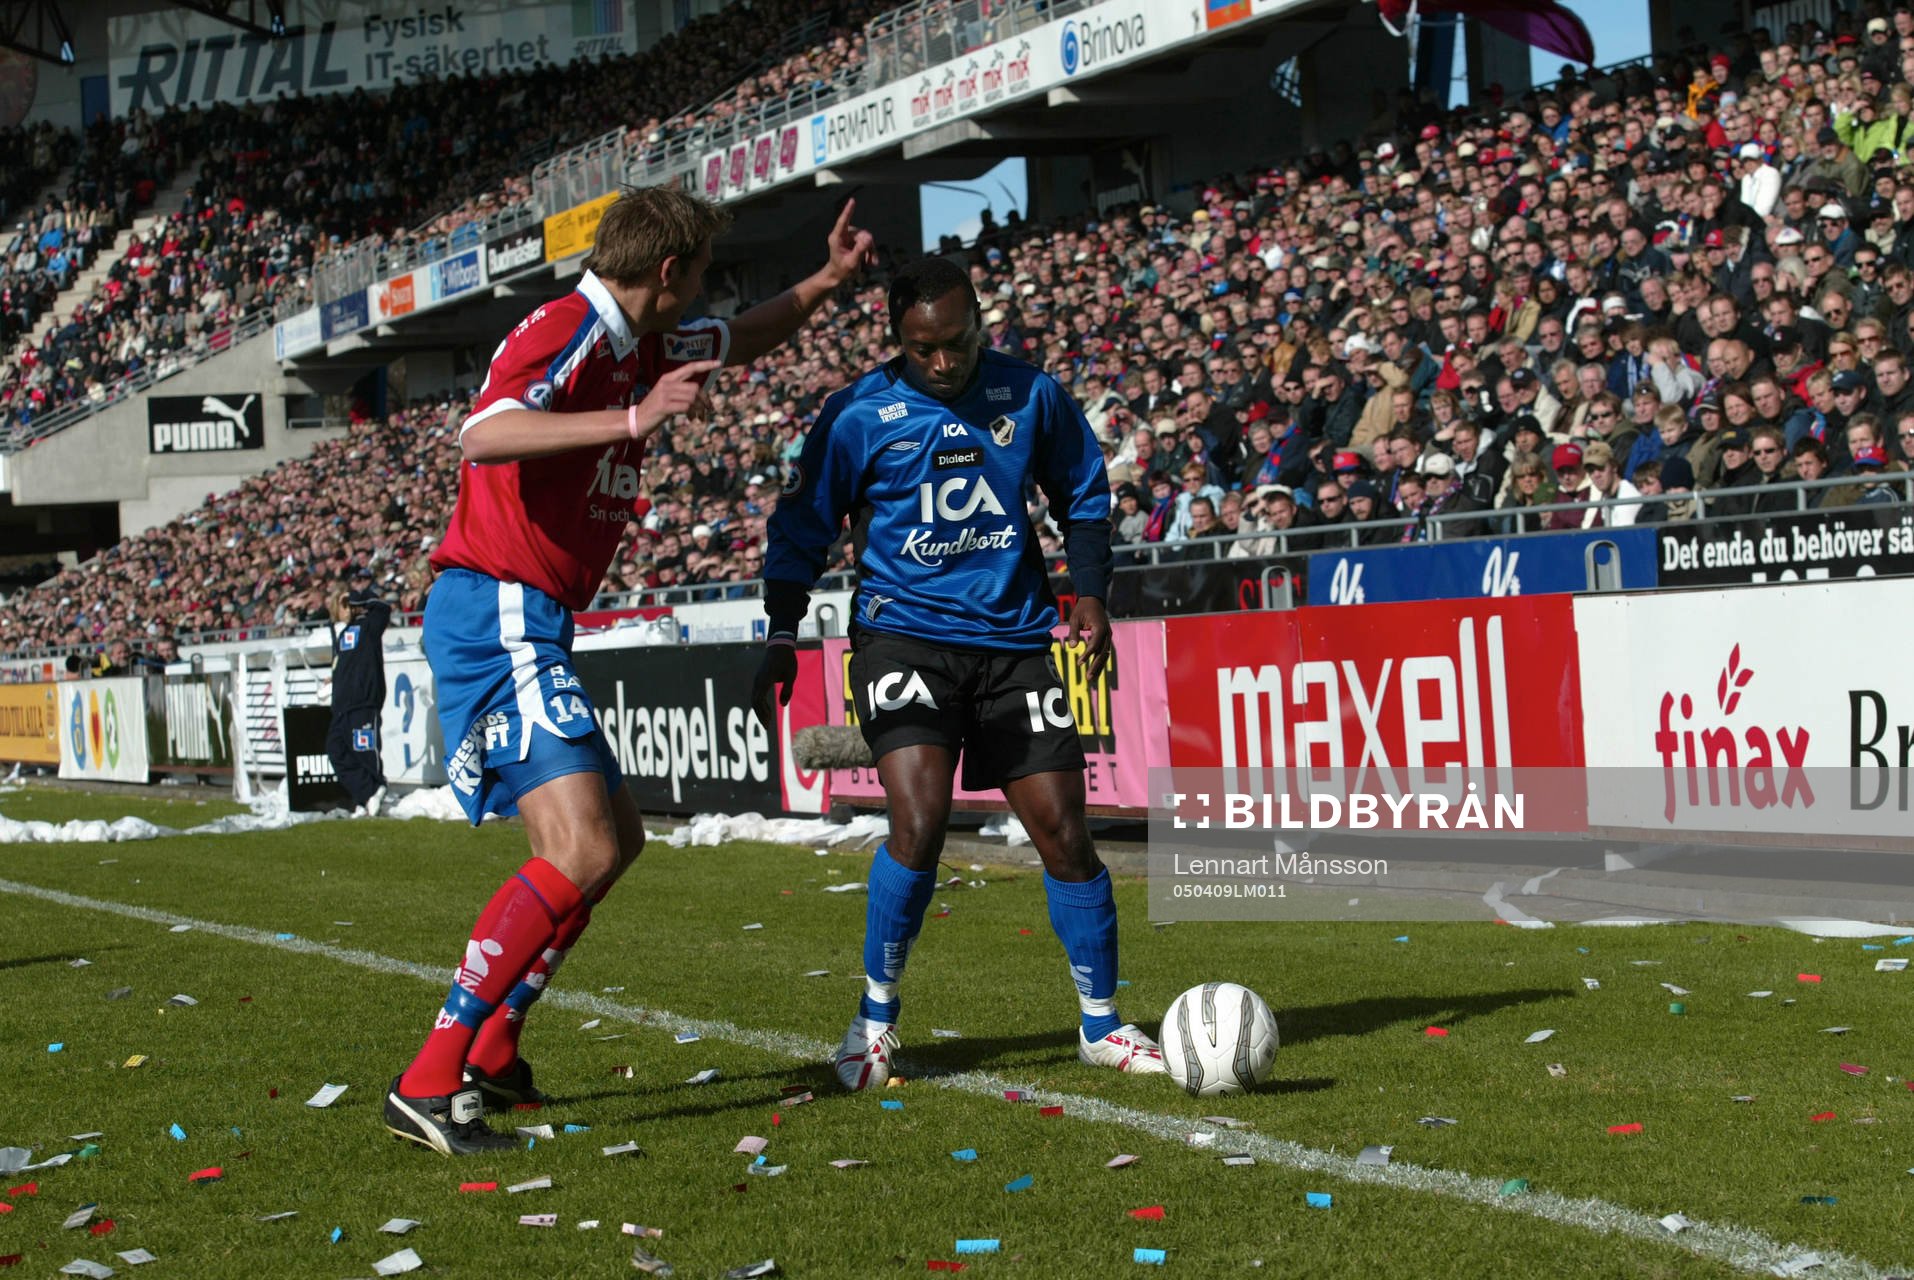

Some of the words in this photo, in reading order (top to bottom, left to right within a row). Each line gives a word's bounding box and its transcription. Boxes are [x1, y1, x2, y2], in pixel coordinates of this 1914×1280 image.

[364, 6, 465, 47] Fysisk
[573, 37, 625, 56] RITTAL
[1080, 13, 1145, 66] Brinova
[118, 21, 347, 111] RITTAL
[366, 34, 549, 80] IT-säkerhet
[829, 96, 896, 154] ARMATUR
[153, 420, 235, 452] PUMA
[943, 424, 969, 437] ICA
[938, 453, 975, 465] Dialect
[920, 474, 1007, 523] ICA
[900, 525, 1017, 567] Kundkort
[1663, 536, 1699, 570] Det
[1703, 530, 1755, 567] enda
[1760, 528, 1788, 563] du
[1792, 521, 1884, 561] behöver
[550, 694, 589, 724] 14
[867, 670, 939, 720] ICA
[1026, 687, 1074, 733] IC
[1217, 615, 1516, 808] maxell
[595, 679, 769, 803] skaspel.se
[1655, 689, 1814, 824] finax
[296, 754, 335, 776] PUM
